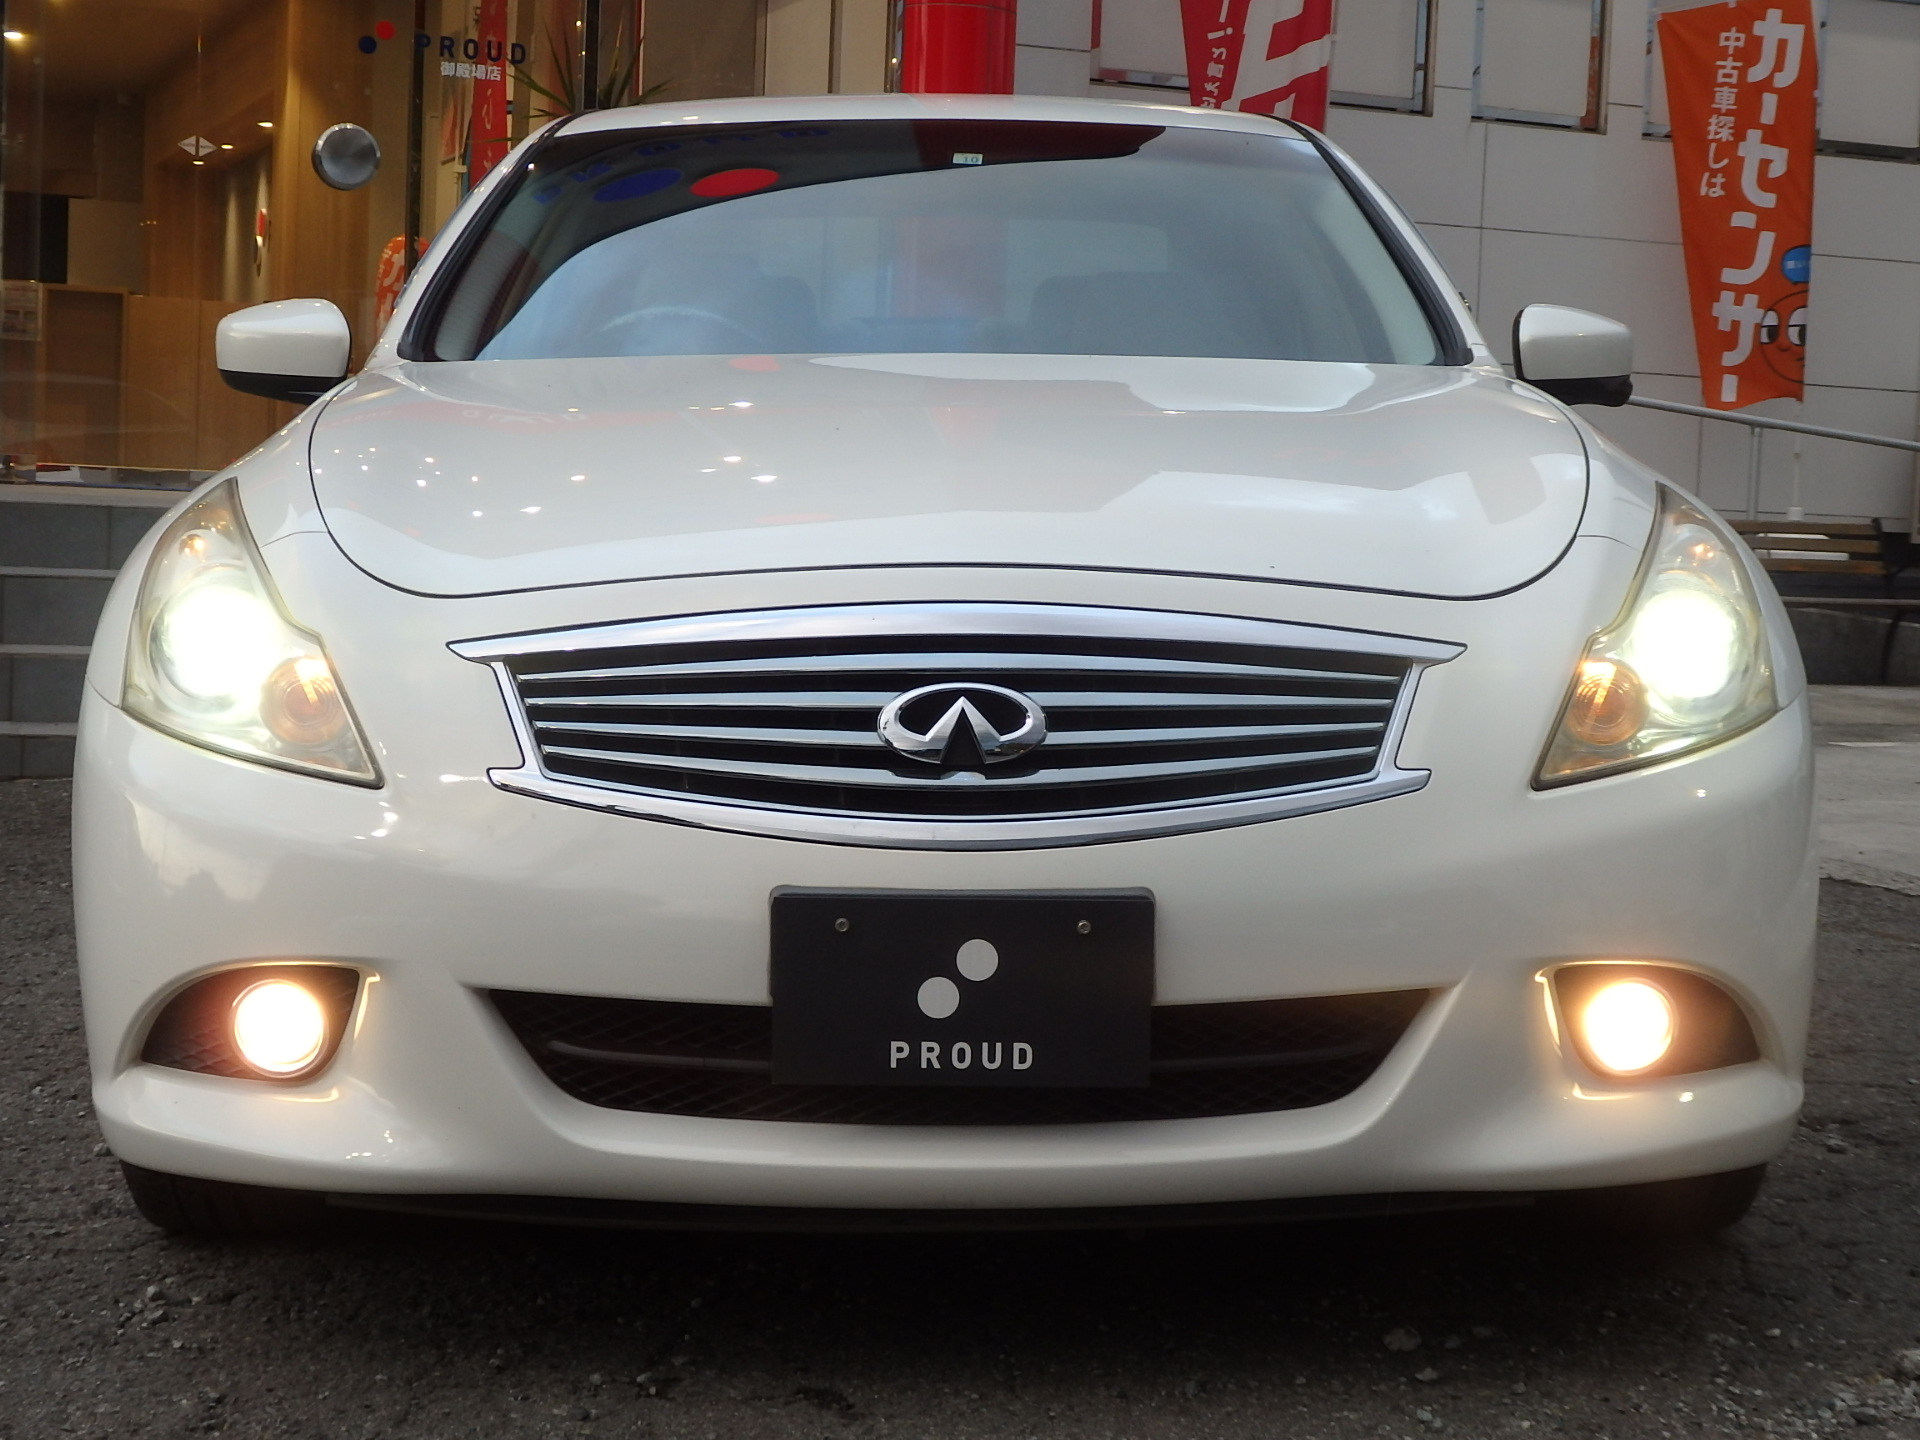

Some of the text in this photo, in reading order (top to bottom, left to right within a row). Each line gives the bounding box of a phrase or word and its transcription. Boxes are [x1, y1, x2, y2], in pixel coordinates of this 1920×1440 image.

[414, 33, 527, 65] PROUD
[440, 61, 502, 81] 御殿場店
[1701, 27, 1746, 197] 中古車探しは
[1712, 8, 1805, 402] カーセンサー
[890, 1041, 1033, 1070] PROUD
